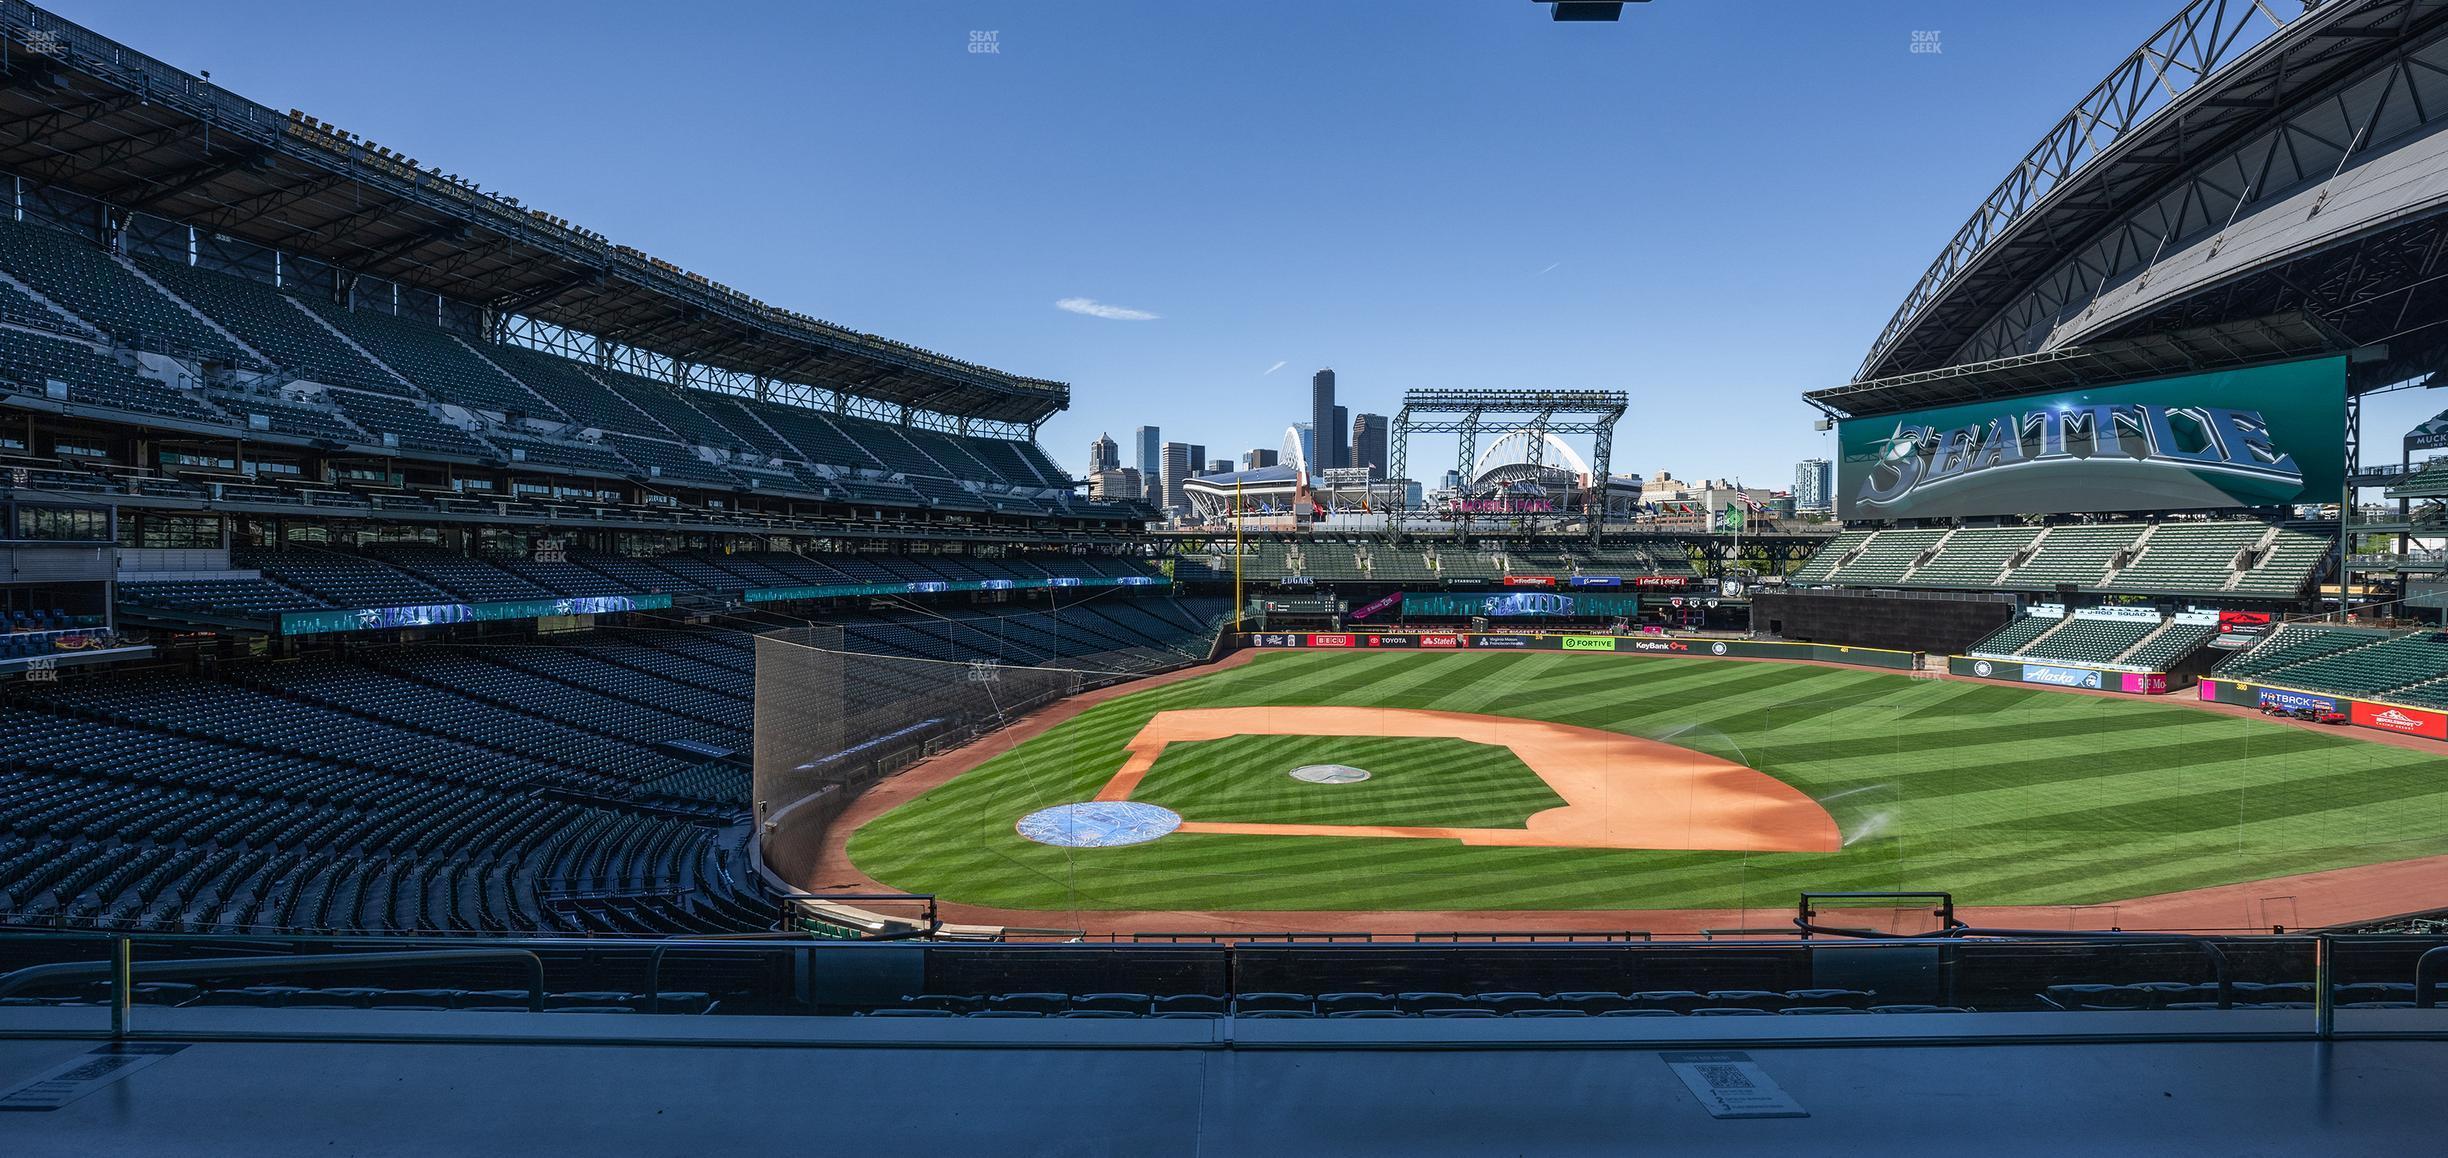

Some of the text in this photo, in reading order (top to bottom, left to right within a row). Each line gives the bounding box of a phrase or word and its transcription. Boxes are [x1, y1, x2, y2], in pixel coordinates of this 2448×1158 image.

[1516, 498, 1553, 513] PARK
[1577, 640, 1612, 648] FORTIVE
[1636, 641, 1669, 650] KeyBank
[2026, 668, 2075, 684] Alaska
